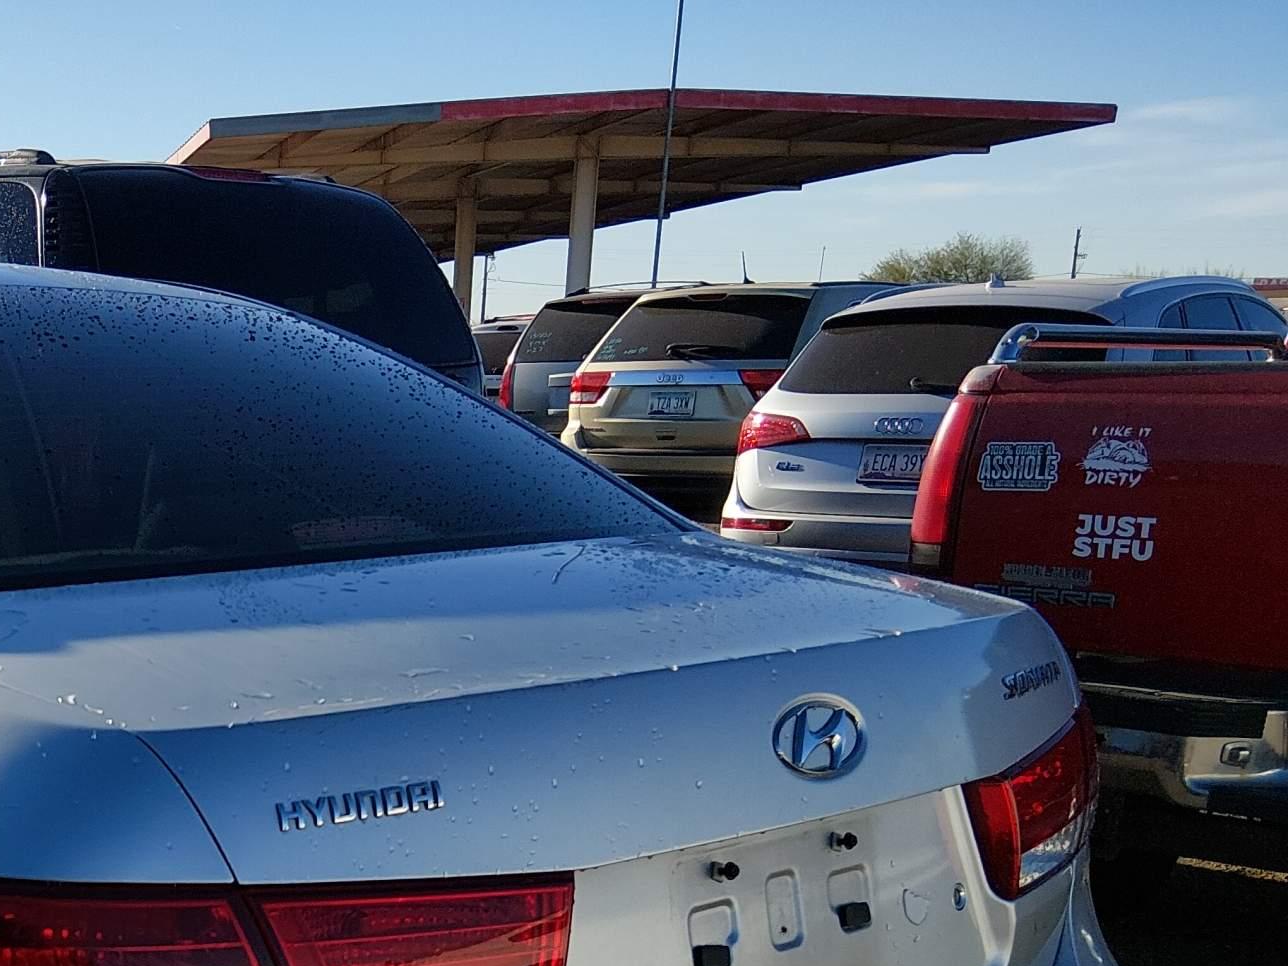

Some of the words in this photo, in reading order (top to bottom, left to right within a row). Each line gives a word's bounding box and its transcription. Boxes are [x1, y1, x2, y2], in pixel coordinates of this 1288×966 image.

[1092, 426, 1098, 436] I
[1102, 426, 1133, 437] LIKE
[1138, 427, 1152, 437] IT
[871, 453, 897, 471] ECA
[980, 455, 1057, 479] ASSHOLE
[1085, 471, 1142, 488] DIRTY
[1075, 513, 1157, 538] JUST
[1072, 536, 1154, 561] STFU
[275, 780, 445, 832] HYUNDAI
